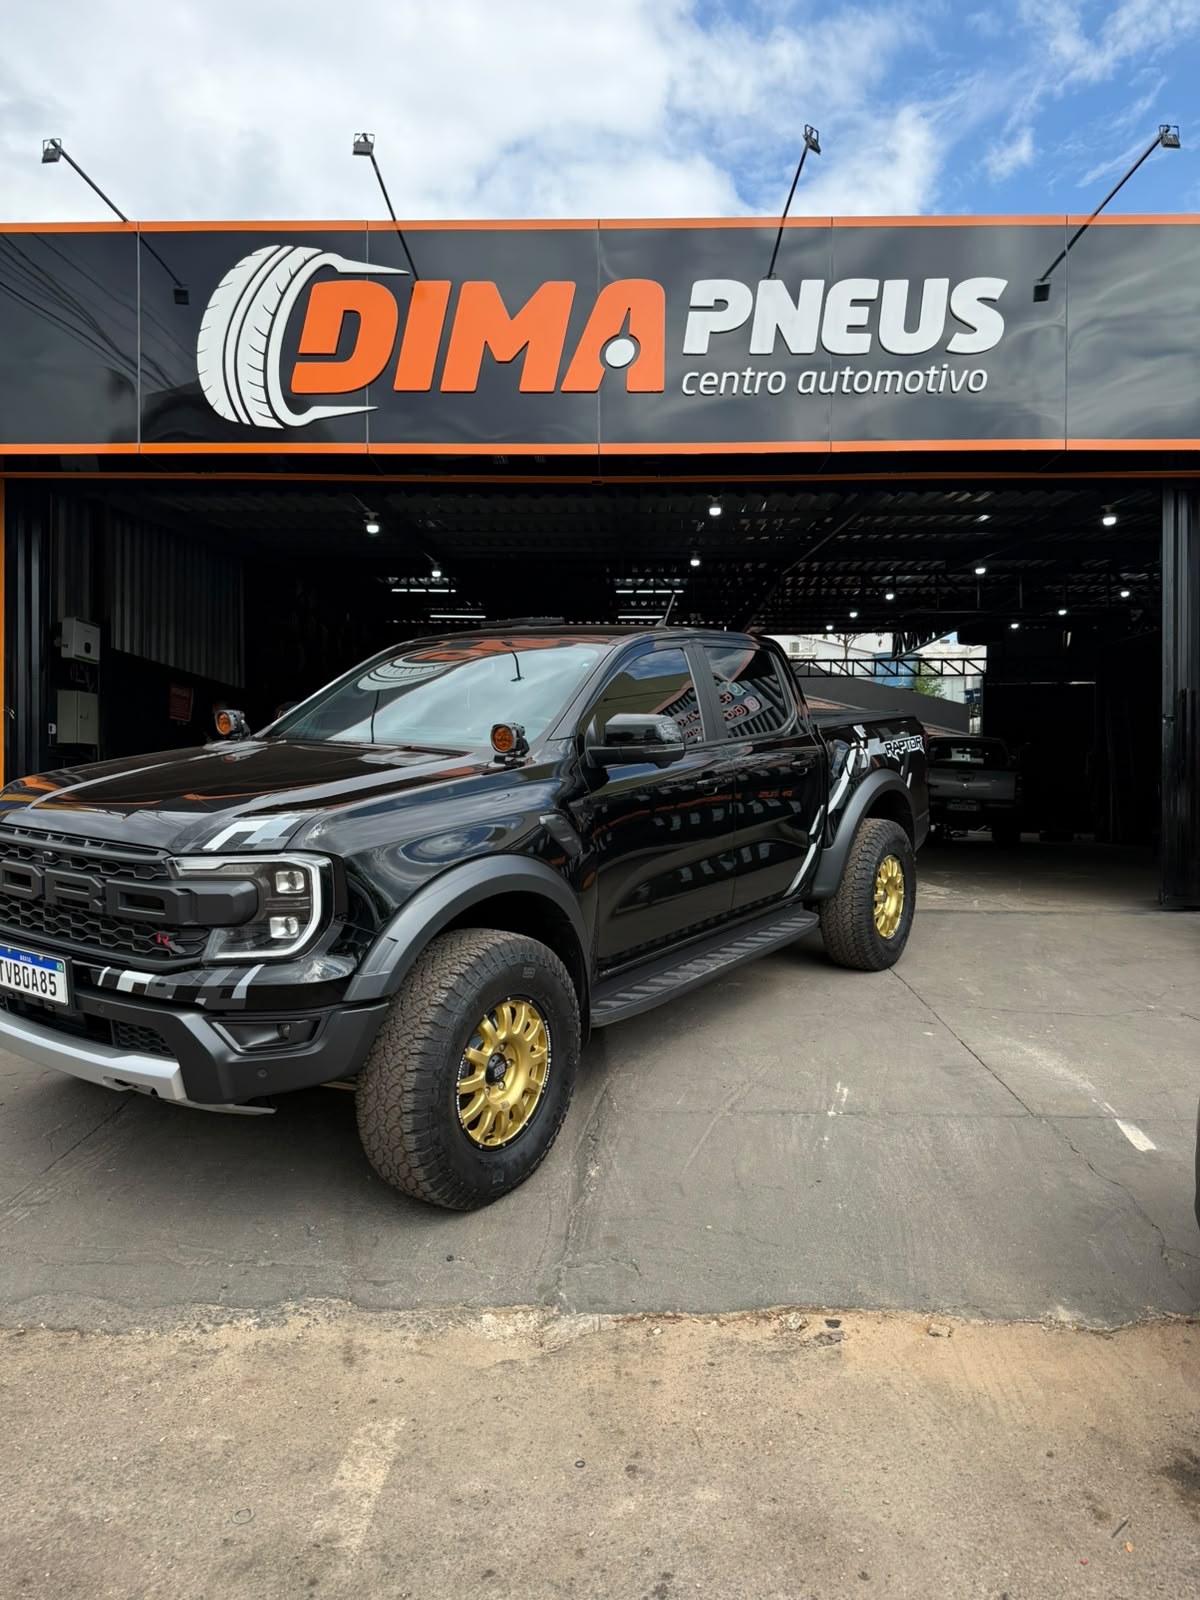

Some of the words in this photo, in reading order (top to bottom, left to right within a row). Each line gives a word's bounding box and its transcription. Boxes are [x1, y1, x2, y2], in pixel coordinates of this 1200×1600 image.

[291, 279, 665, 394] DIMA
[683, 277, 1008, 355] PNEUS
[682, 366, 787, 395] centro
[797, 364, 988, 395] automotivo
[883, 735, 925, 761] RAPTOR
